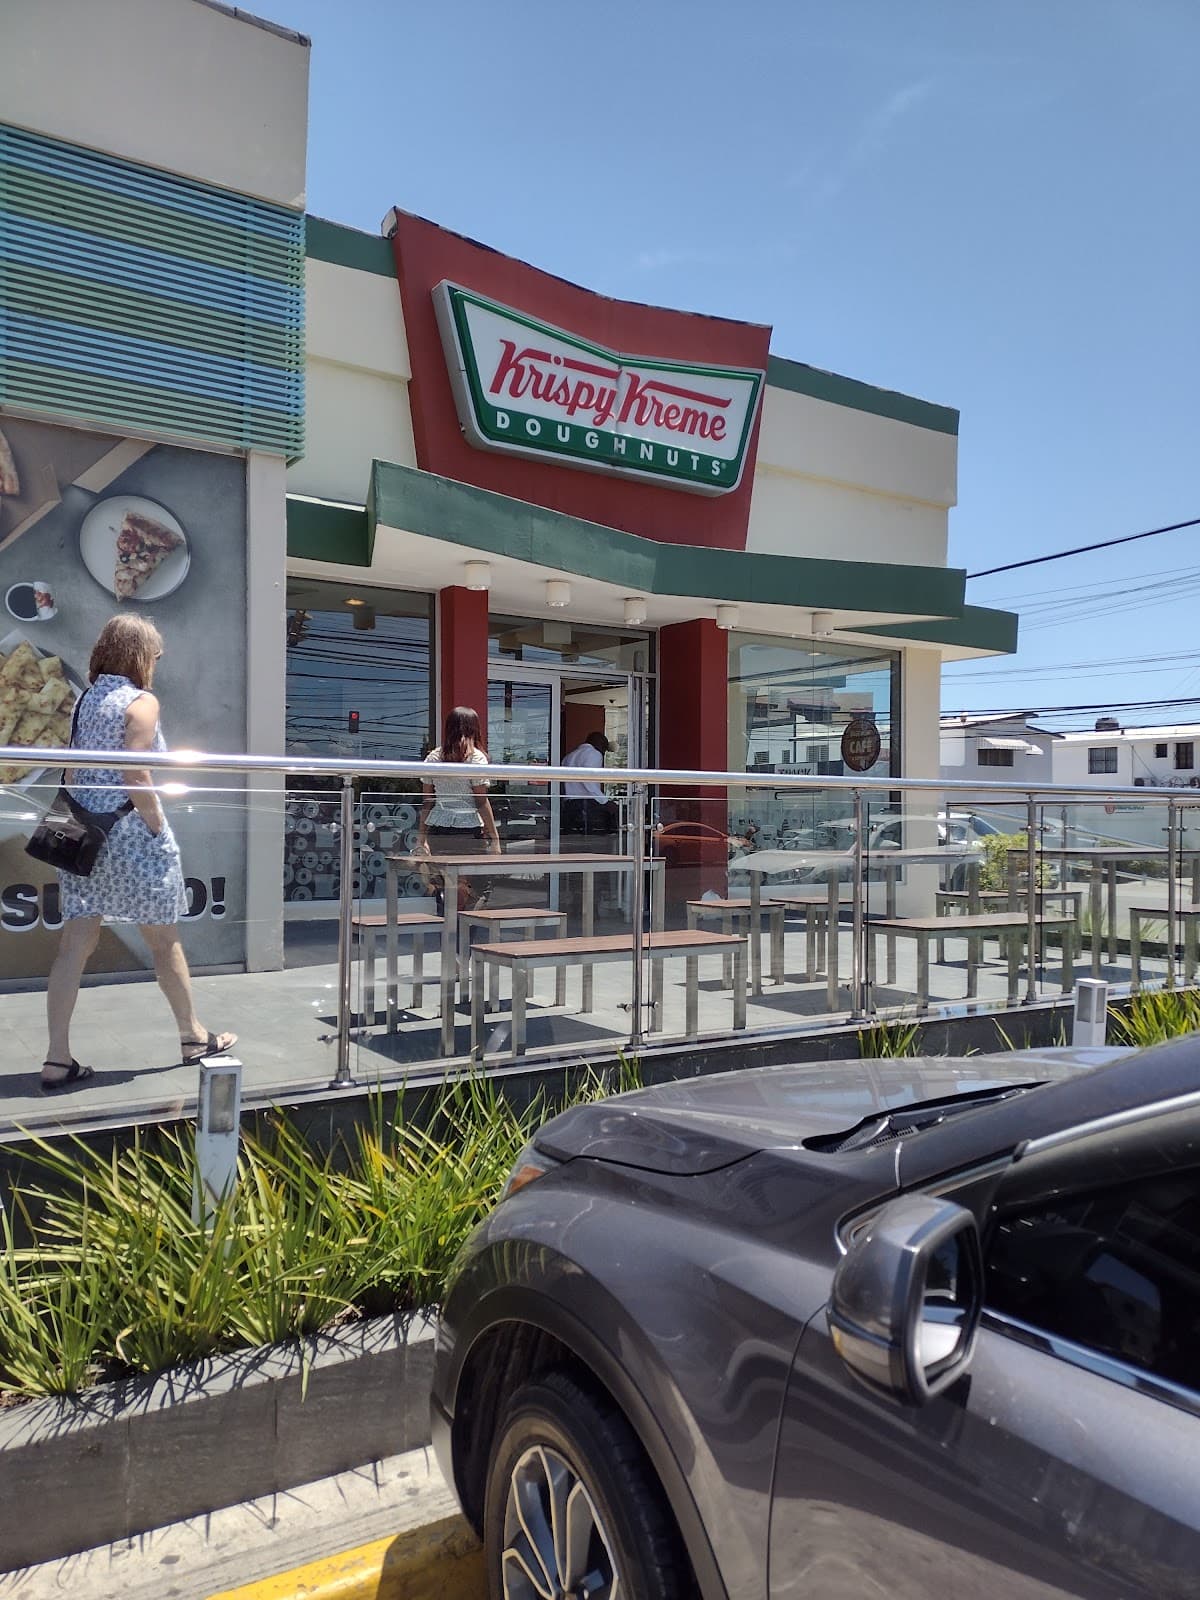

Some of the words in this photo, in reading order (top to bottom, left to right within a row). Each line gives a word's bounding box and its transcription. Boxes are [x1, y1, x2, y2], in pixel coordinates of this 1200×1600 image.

[489, 338, 622, 427] Krispy
[618, 371, 732, 441] Kreme
[496, 411, 721, 476] DOUGHNUTS
